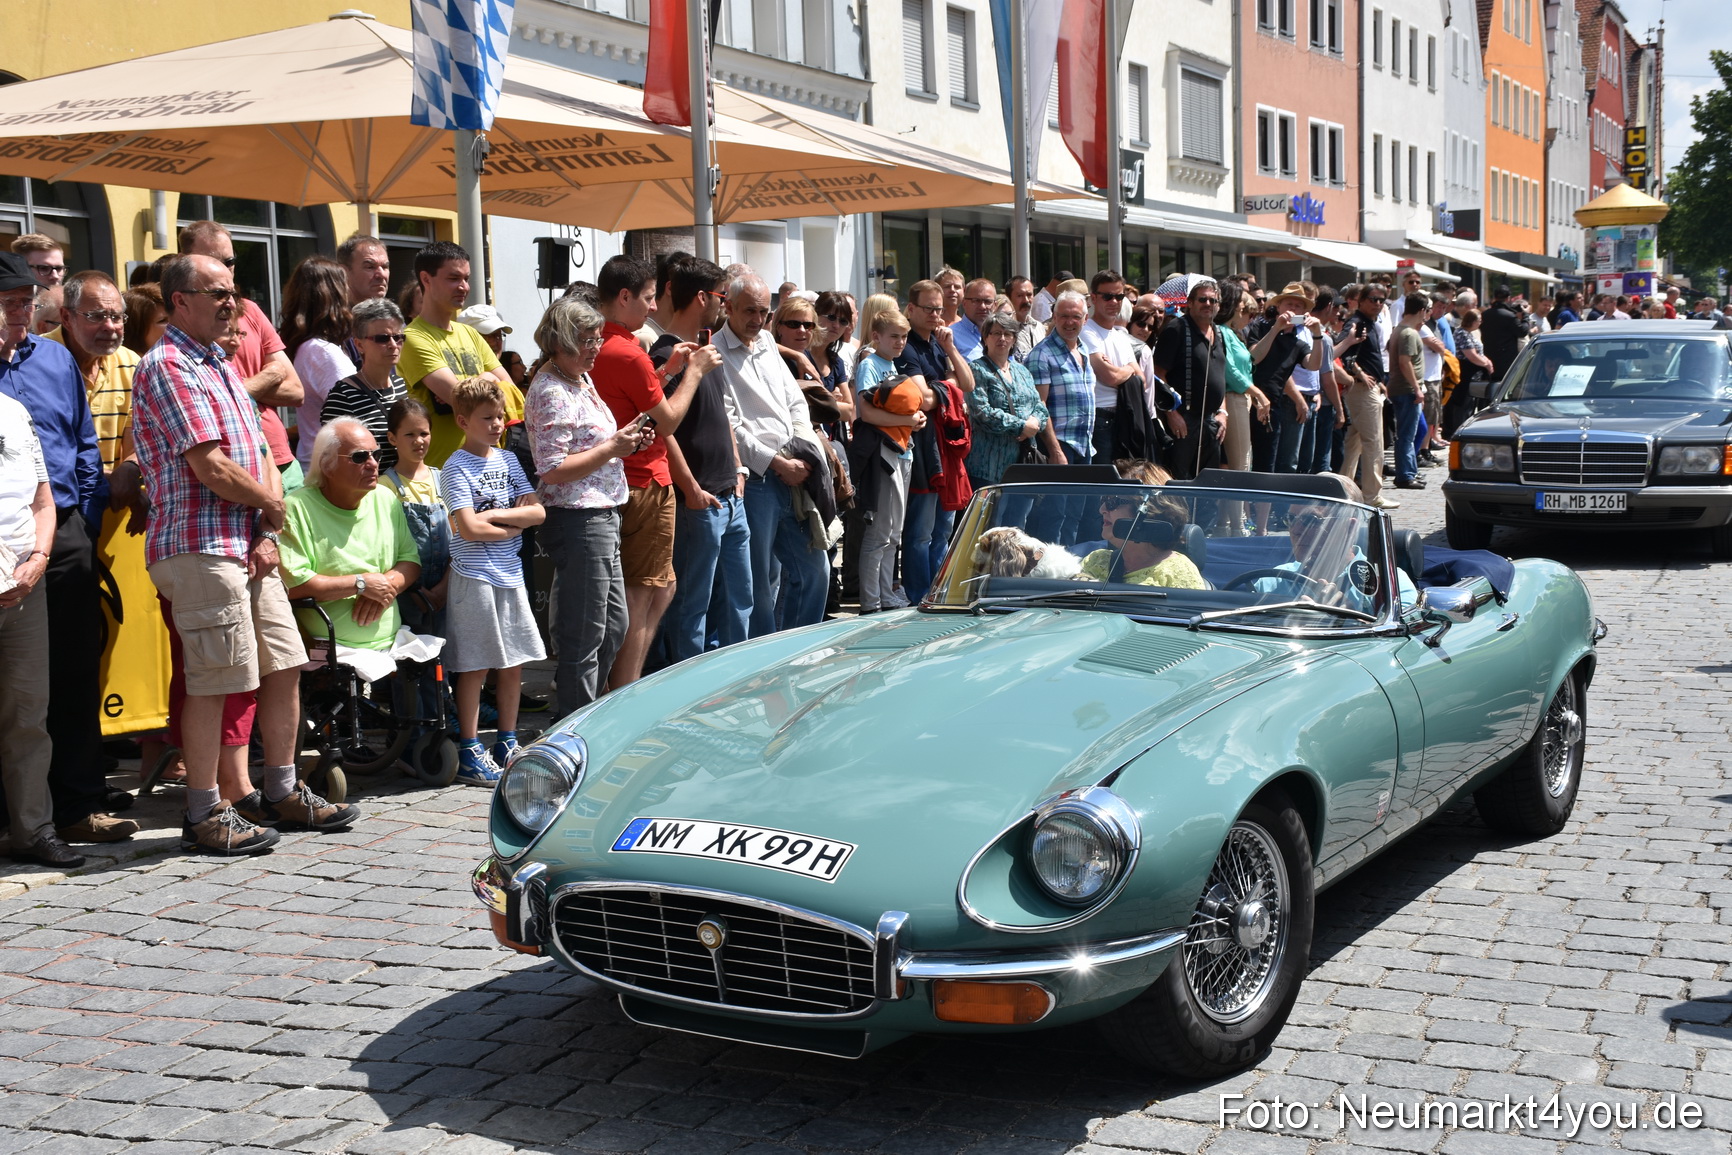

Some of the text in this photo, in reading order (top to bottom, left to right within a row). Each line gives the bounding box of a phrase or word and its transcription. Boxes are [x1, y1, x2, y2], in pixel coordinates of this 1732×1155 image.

[1544, 494, 1561, 508] RH
[1569, 494, 1587, 509] MB
[636, 821, 695, 849] NM
